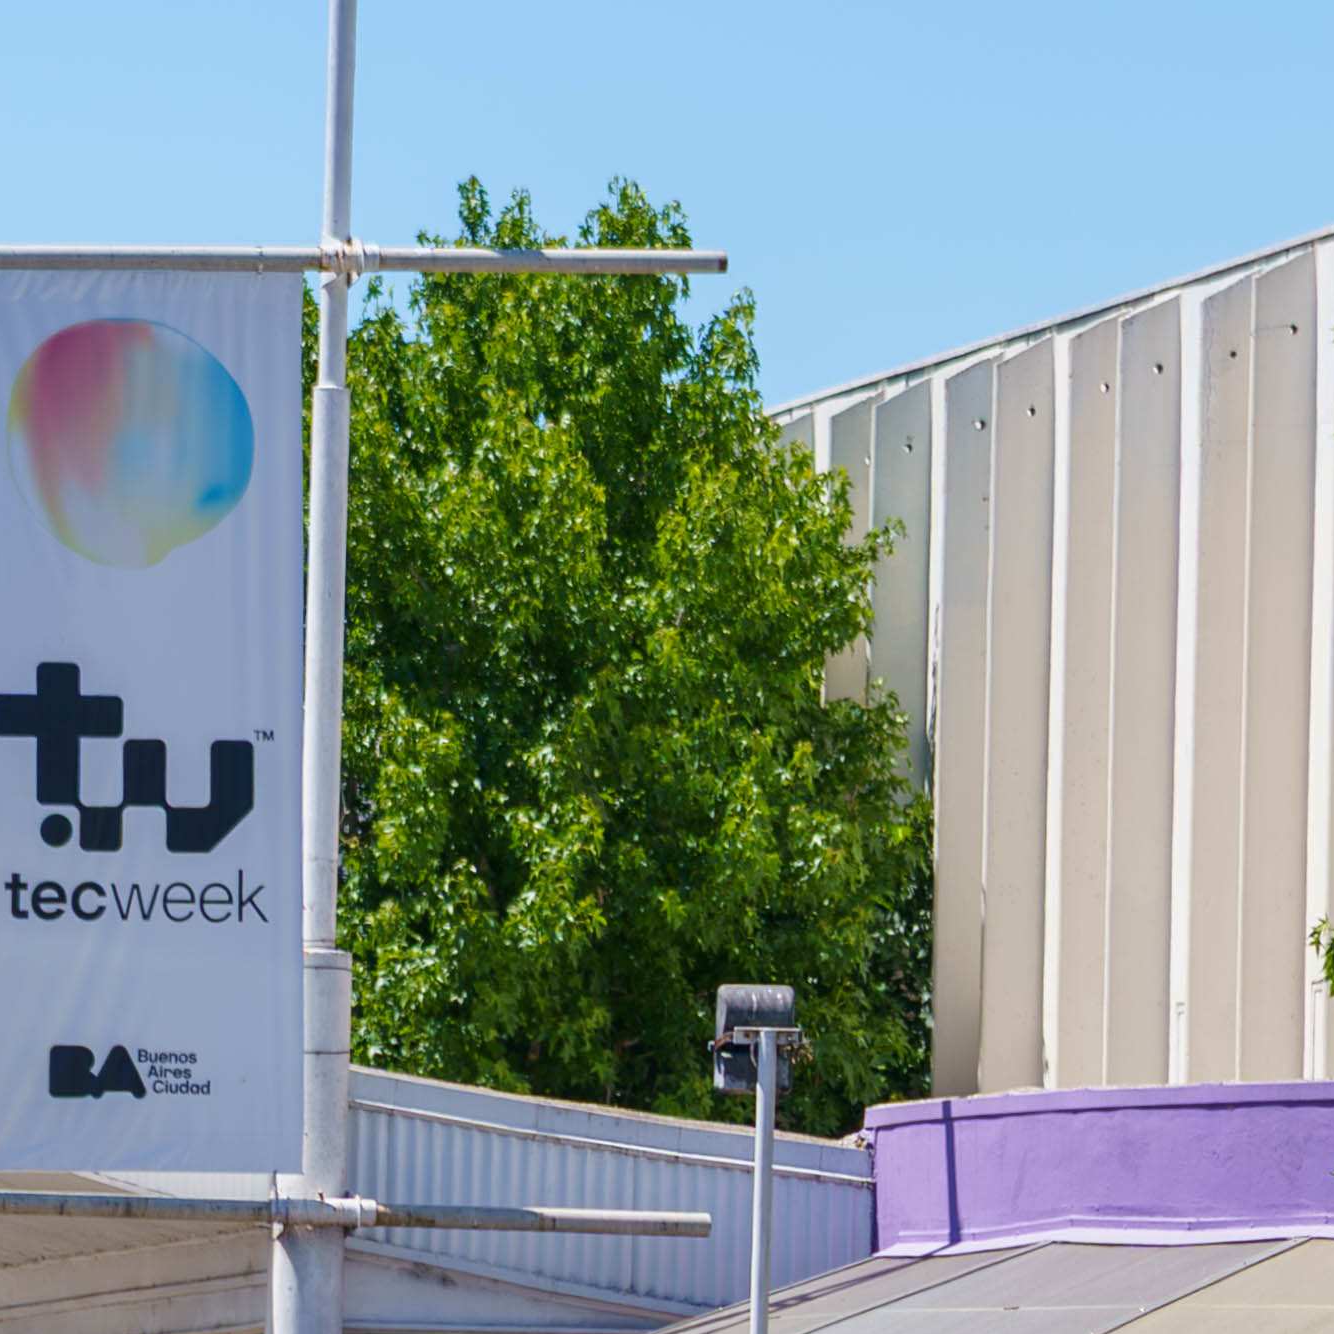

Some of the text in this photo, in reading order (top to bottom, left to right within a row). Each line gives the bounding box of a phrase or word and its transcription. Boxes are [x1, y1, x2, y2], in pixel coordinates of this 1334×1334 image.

[4, 869, 269, 923] tecweek
[137, 1048, 198, 1064] Buenos
[49, 1045, 146, 1099] BA
[147, 1065, 193, 1080] Aires
[152, 1080, 212, 1096] Ciudad
